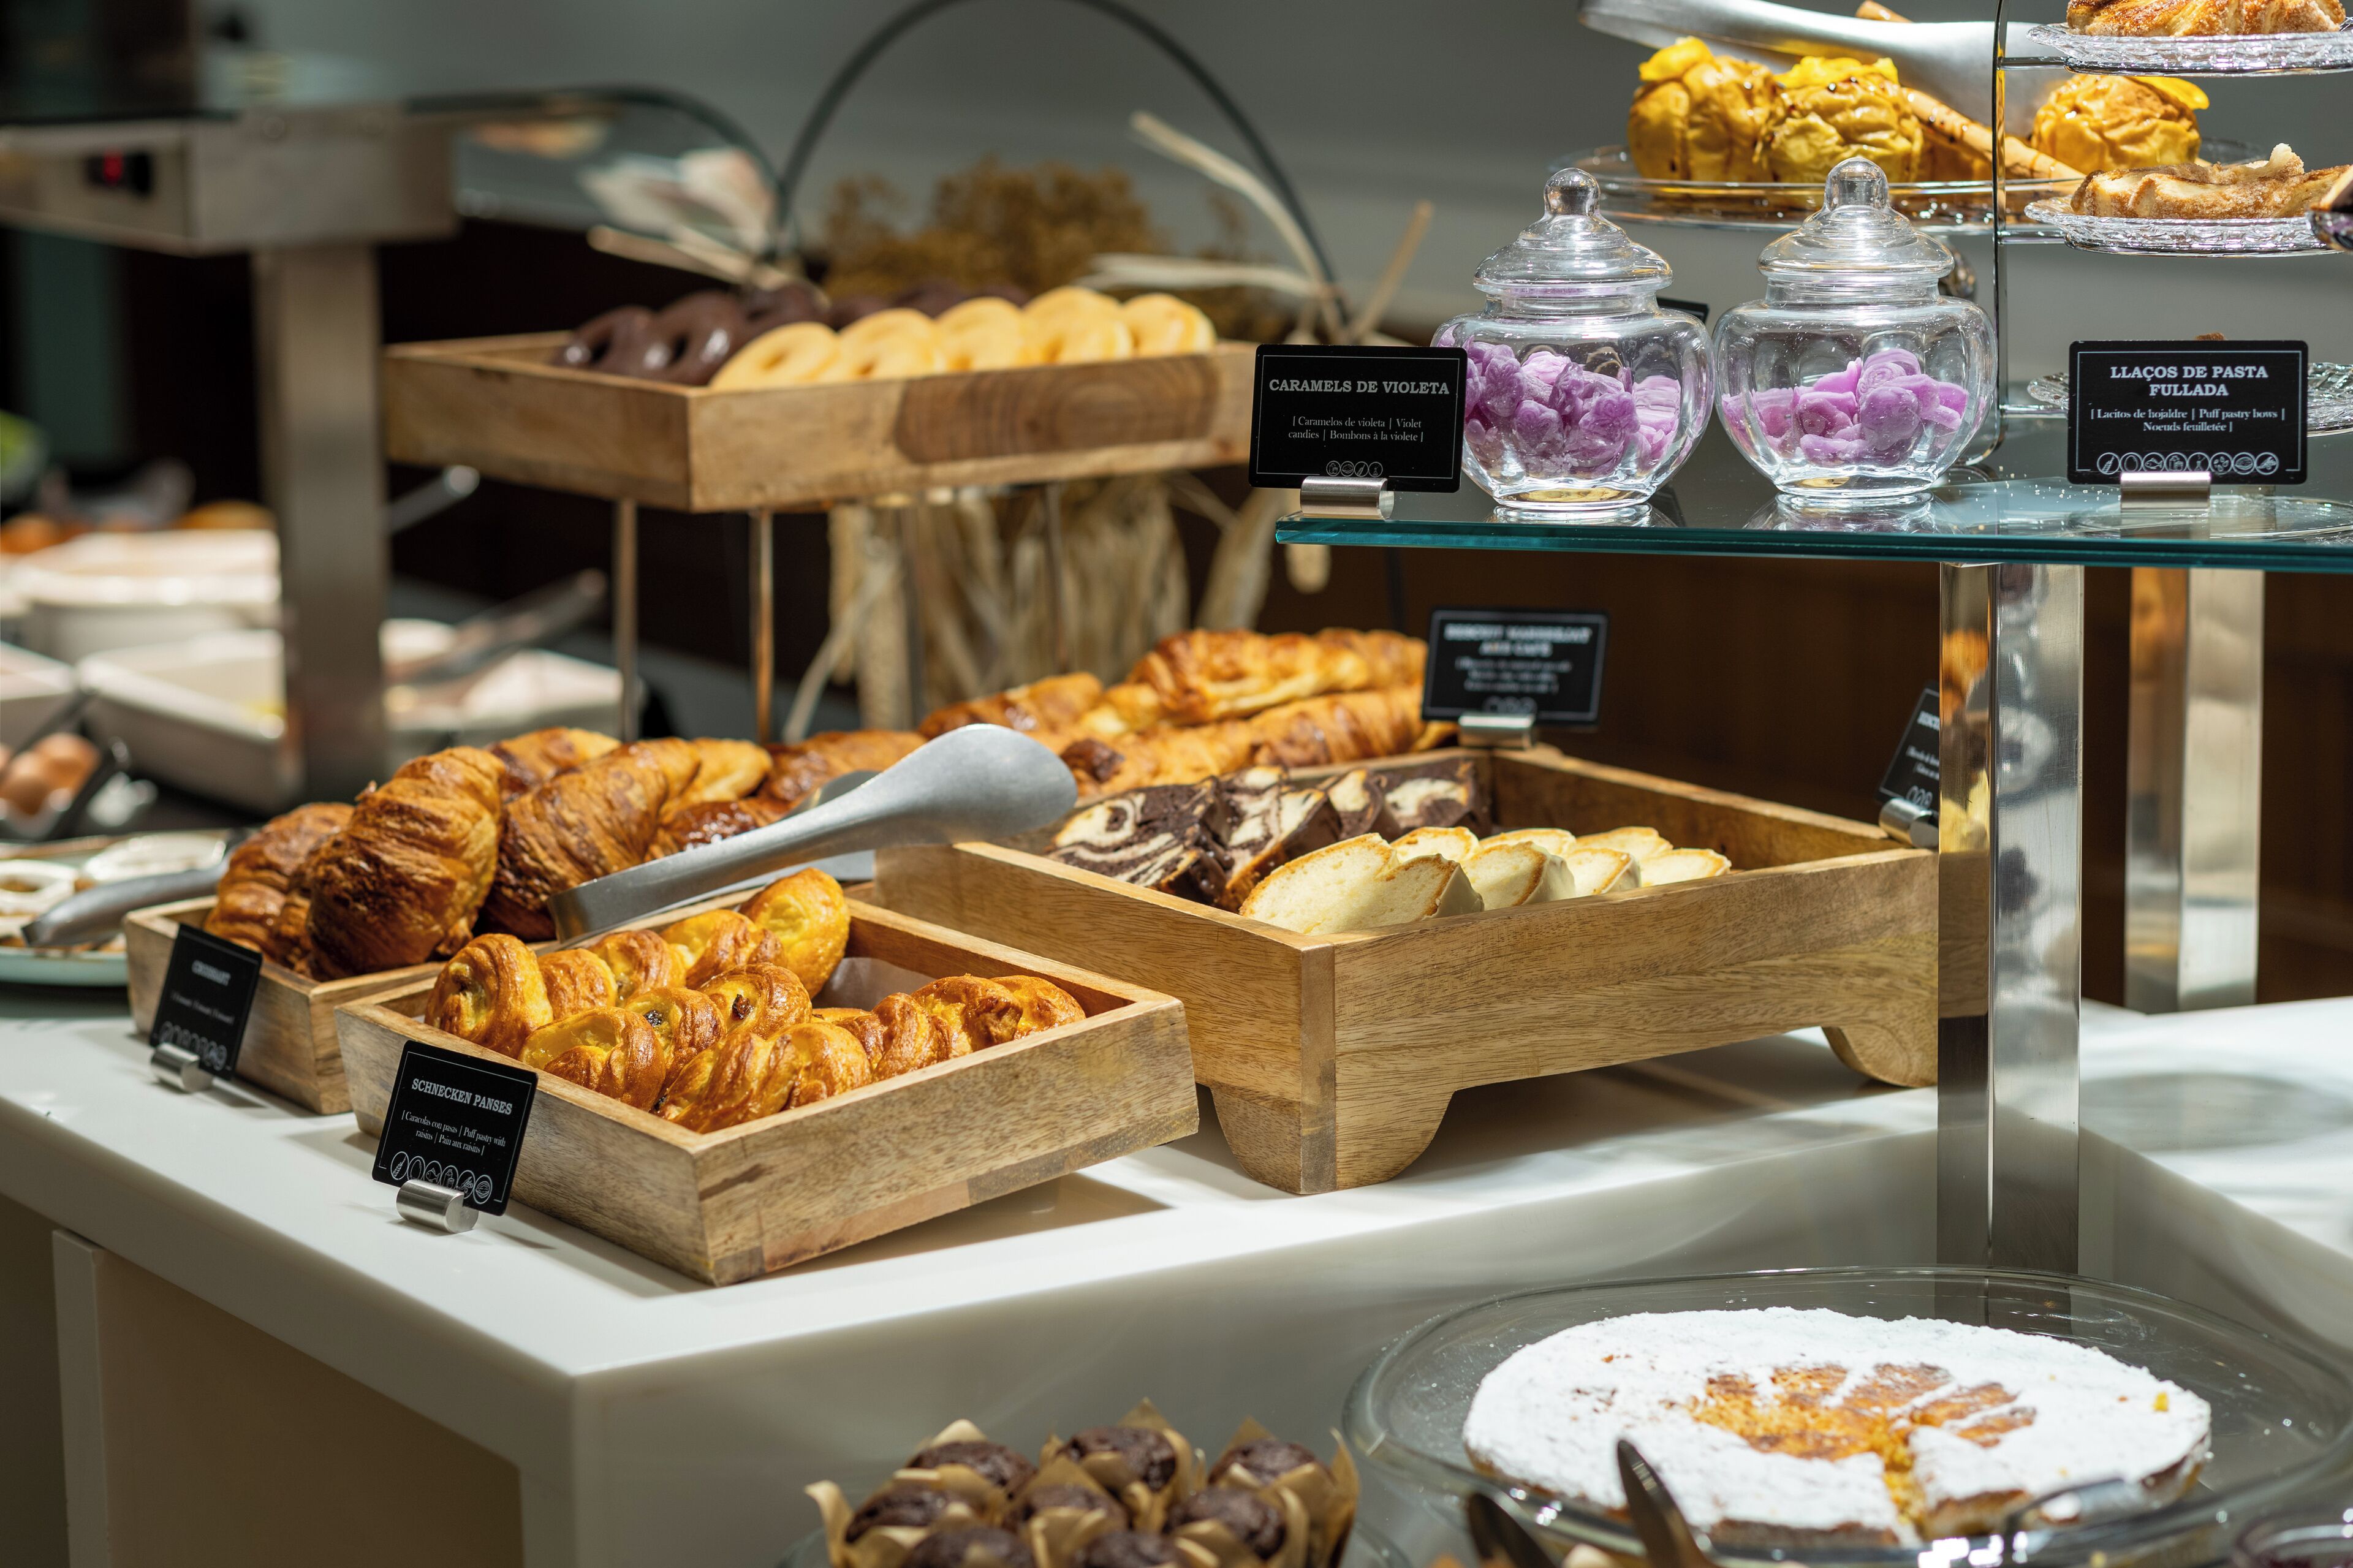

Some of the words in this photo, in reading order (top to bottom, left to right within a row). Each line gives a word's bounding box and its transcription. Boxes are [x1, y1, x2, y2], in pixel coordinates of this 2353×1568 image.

[2110, 366, 2178, 381] LLAÇOS
[2182, 366, 2207, 378] DE
[2211, 366, 2268, 378] PASTA
[1269, 379, 1352, 393] CARAMELS
[1356, 381, 1378, 393] DE
[1382, 381, 1450, 394] VIOLETA
[2149, 384, 2229, 396] FULLADA
[1298, 416, 1343, 426] Caramelos
[1344, 417, 1355, 426] de
[1358, 417, 1385, 427] violeta
[1396, 419, 1422, 428] Violet
[2097, 409, 2131, 419] Lacitos
[2133, 409, 2146, 419] de
[2148, 409, 2188, 420] hojaldre
[2199, 409, 2221, 419] Puff
[2221, 410, 2251, 420] pastry
[2253, 409, 2278, 419] bows
[1288, 429, 1319, 439] candies
[1330, 430, 1371, 440] Bombons
[1373, 431, 1378, 440] à
[1381, 431, 1388, 441] la
[1390, 431, 1419, 441] violete
[411, 1078, 472, 1105] SCHNECKEN
[472, 1094, 513, 1115] PANSES
[405, 1111, 431, 1126] Caracolas
[442, 1124, 458, 1134] pasas
[463, 1127, 478, 1139] Puff
[476, 1133, 493, 1145] pastry
[493, 1135, 506, 1147] with
[415, 1128, 433, 1140] raisins
[438, 1134, 452, 1145] Pain
[452, 1140, 463, 1149] aux
[462, 1142, 480, 1154] raisins
